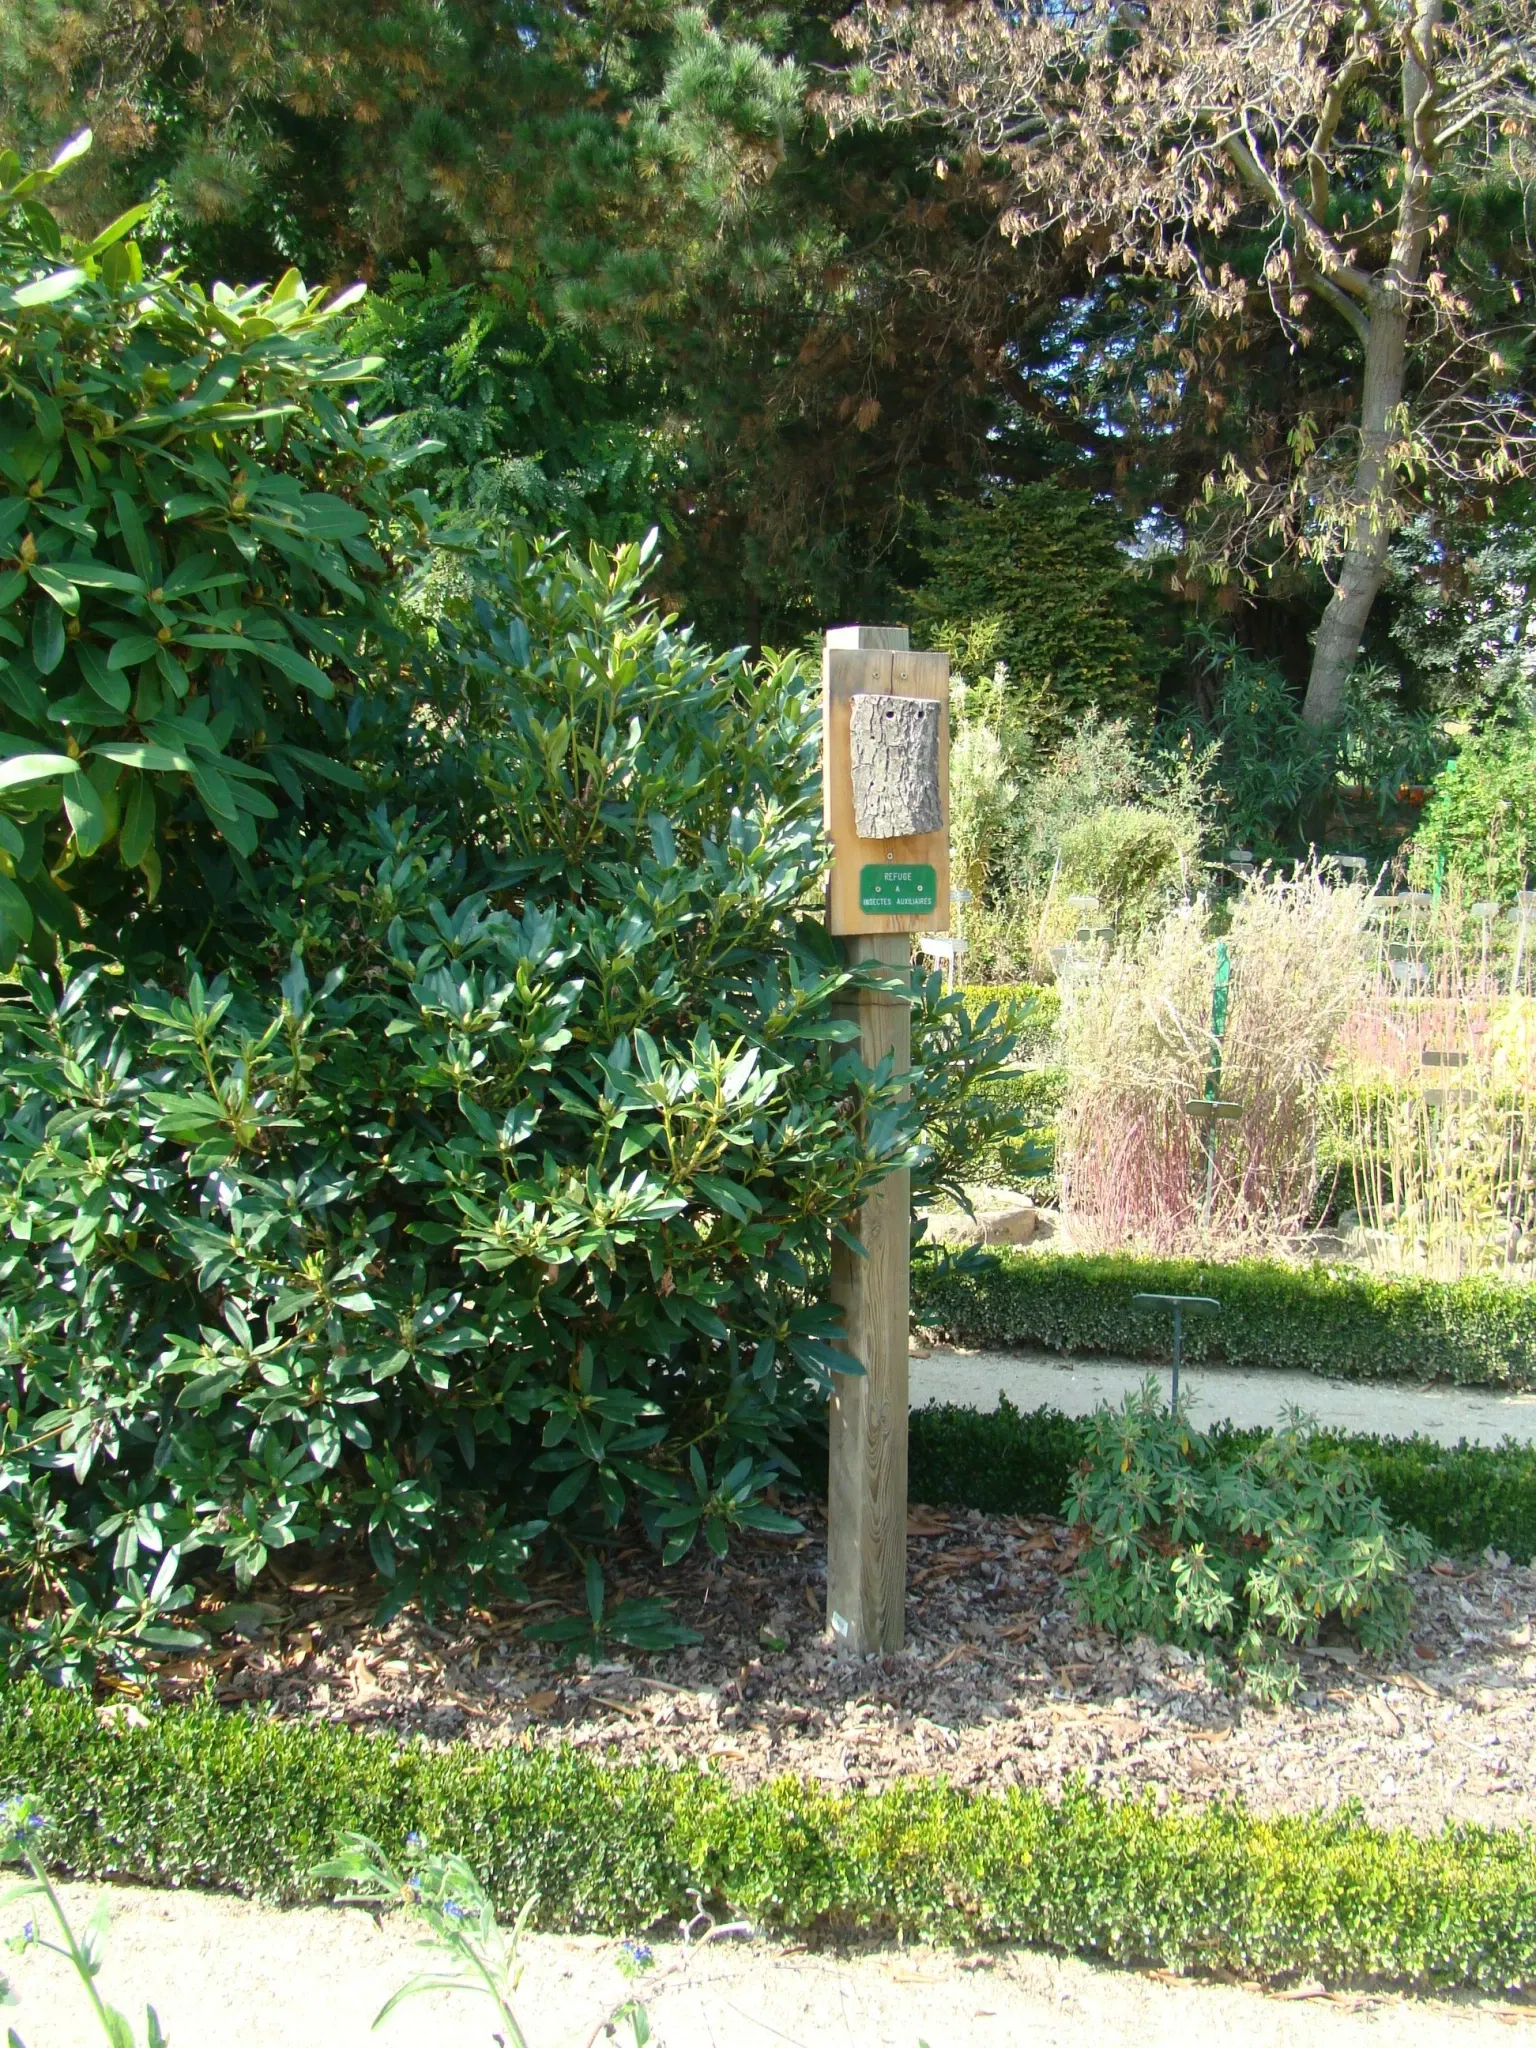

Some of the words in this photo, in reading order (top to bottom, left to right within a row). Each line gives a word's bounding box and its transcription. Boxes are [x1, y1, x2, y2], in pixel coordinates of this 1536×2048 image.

[884, 872, 912, 881] REFUGE
[863, 898, 891, 906] INSECTES
[896, 897, 932, 905] AUXILIAIRES
